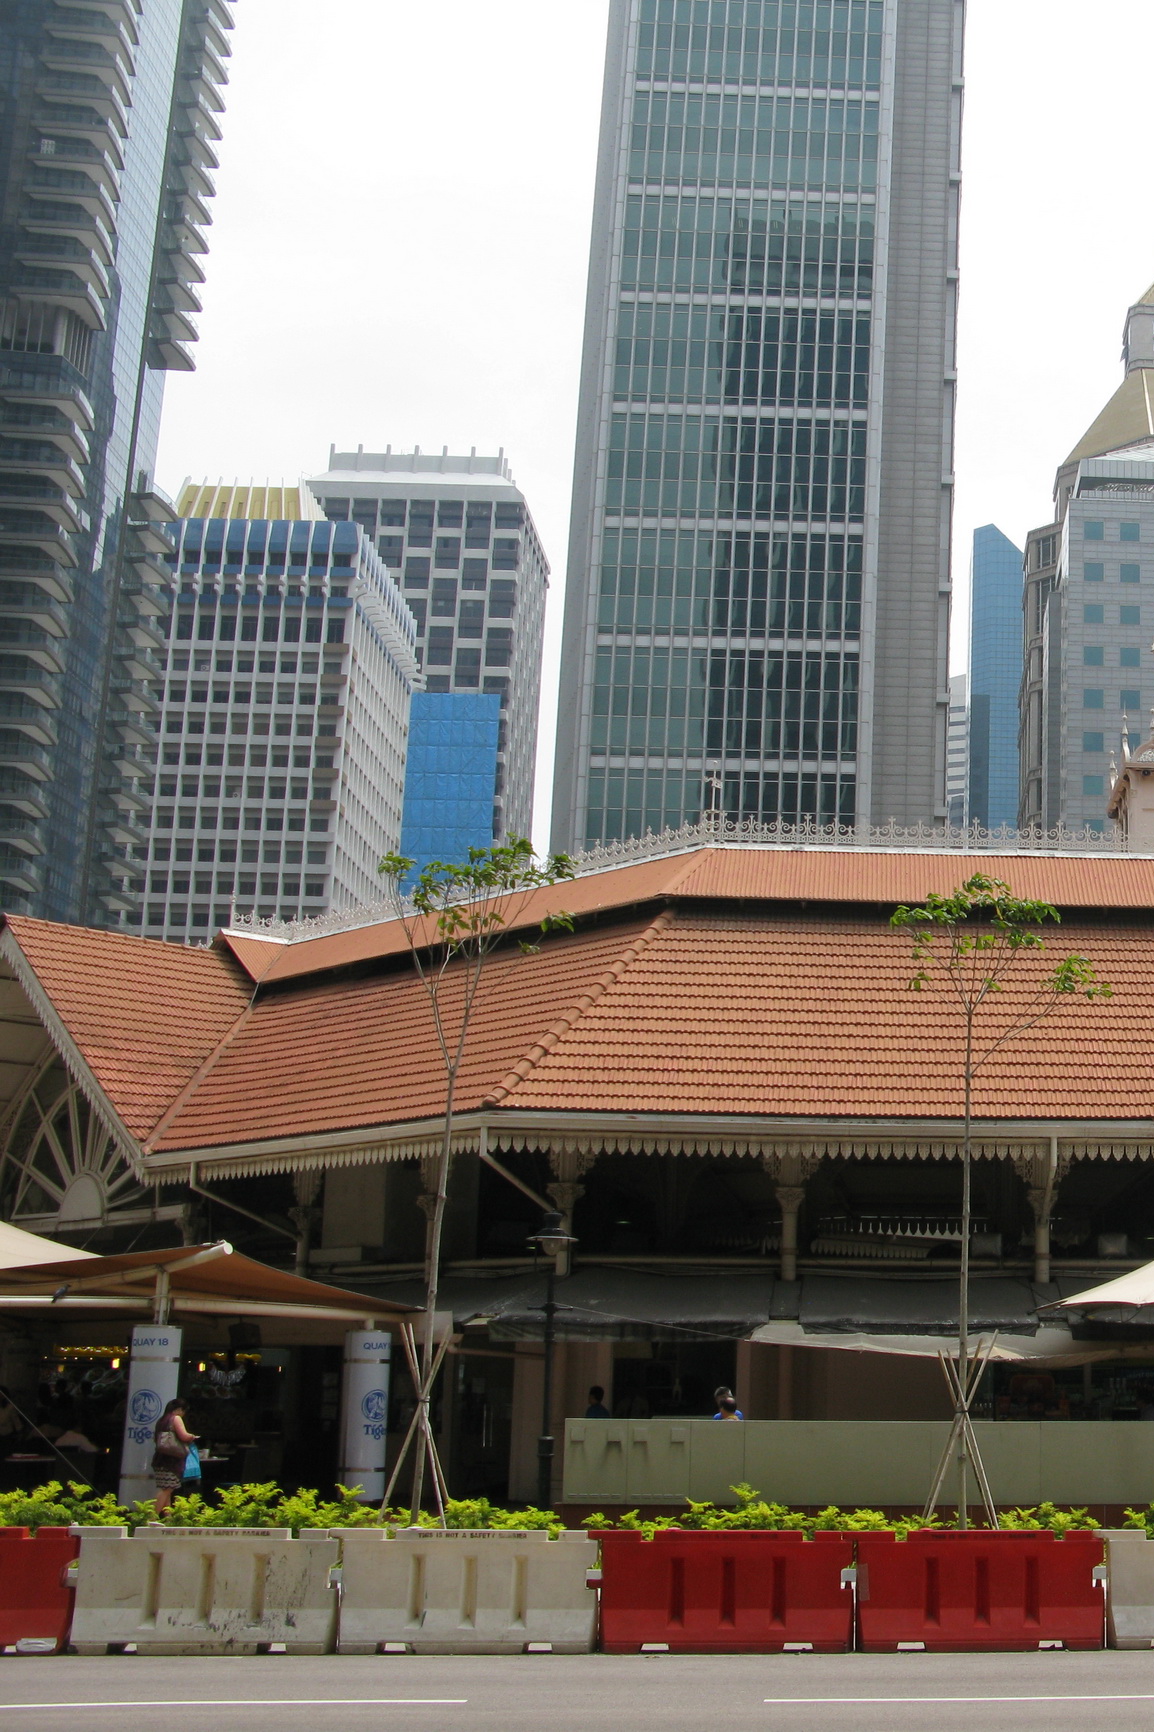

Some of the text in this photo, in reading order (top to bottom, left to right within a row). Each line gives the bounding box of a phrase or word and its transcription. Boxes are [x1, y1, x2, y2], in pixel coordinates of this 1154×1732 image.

[132, 1338, 169, 1346] QUAY 18
[363, 1342, 387, 1350] QUAY
[128, 1426, 154, 1444] Tige
